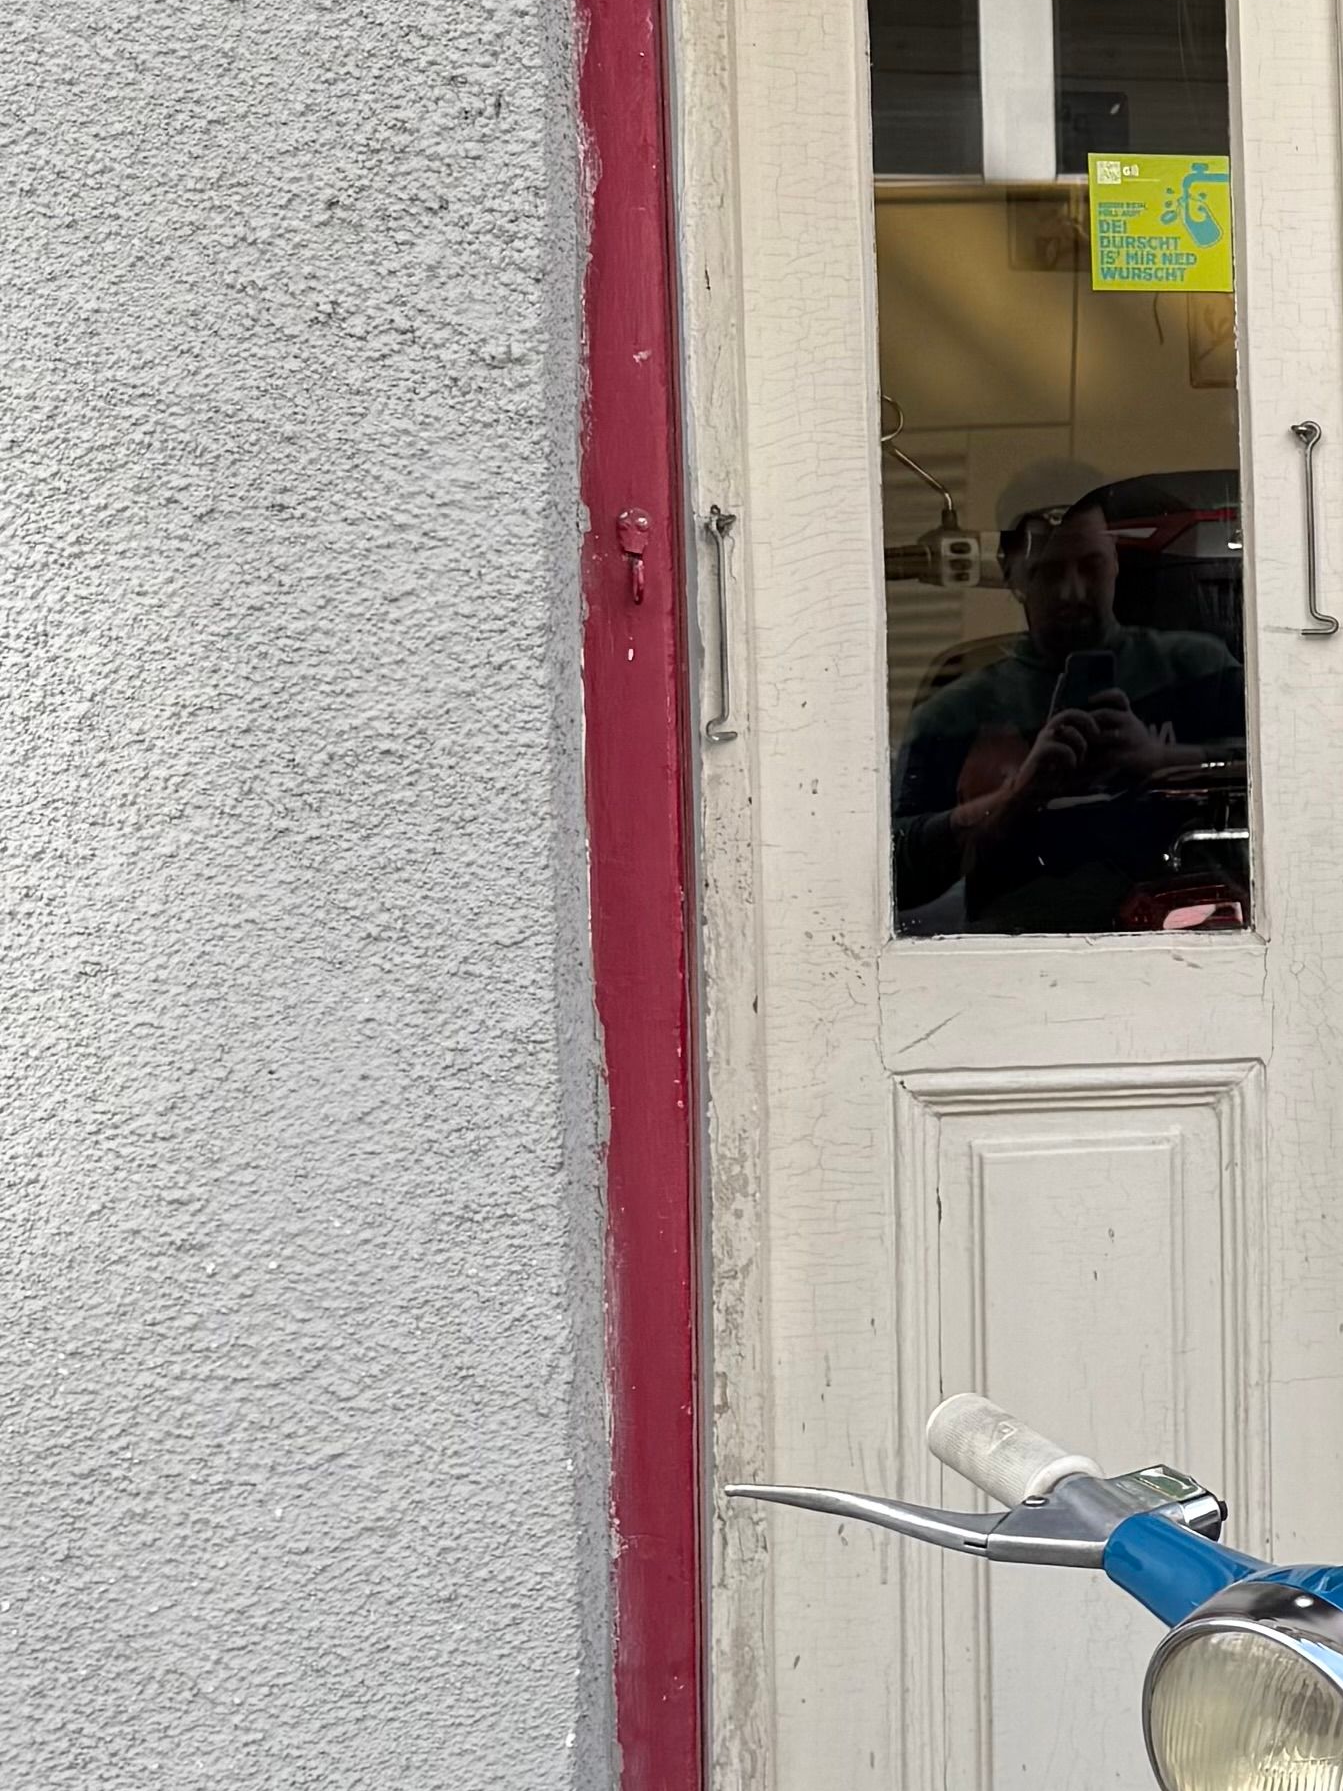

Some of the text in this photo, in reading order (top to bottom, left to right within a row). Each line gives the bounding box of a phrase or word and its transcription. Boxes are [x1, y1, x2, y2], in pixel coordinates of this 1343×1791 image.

[1099, 219, 1128, 234] DEI
[1100, 235, 1181, 250] DURSCHT
[1125, 252, 1157, 266] MIR
[1162, 253, 1198, 266] NED
[1101, 267, 1187, 282] WURSCHT
